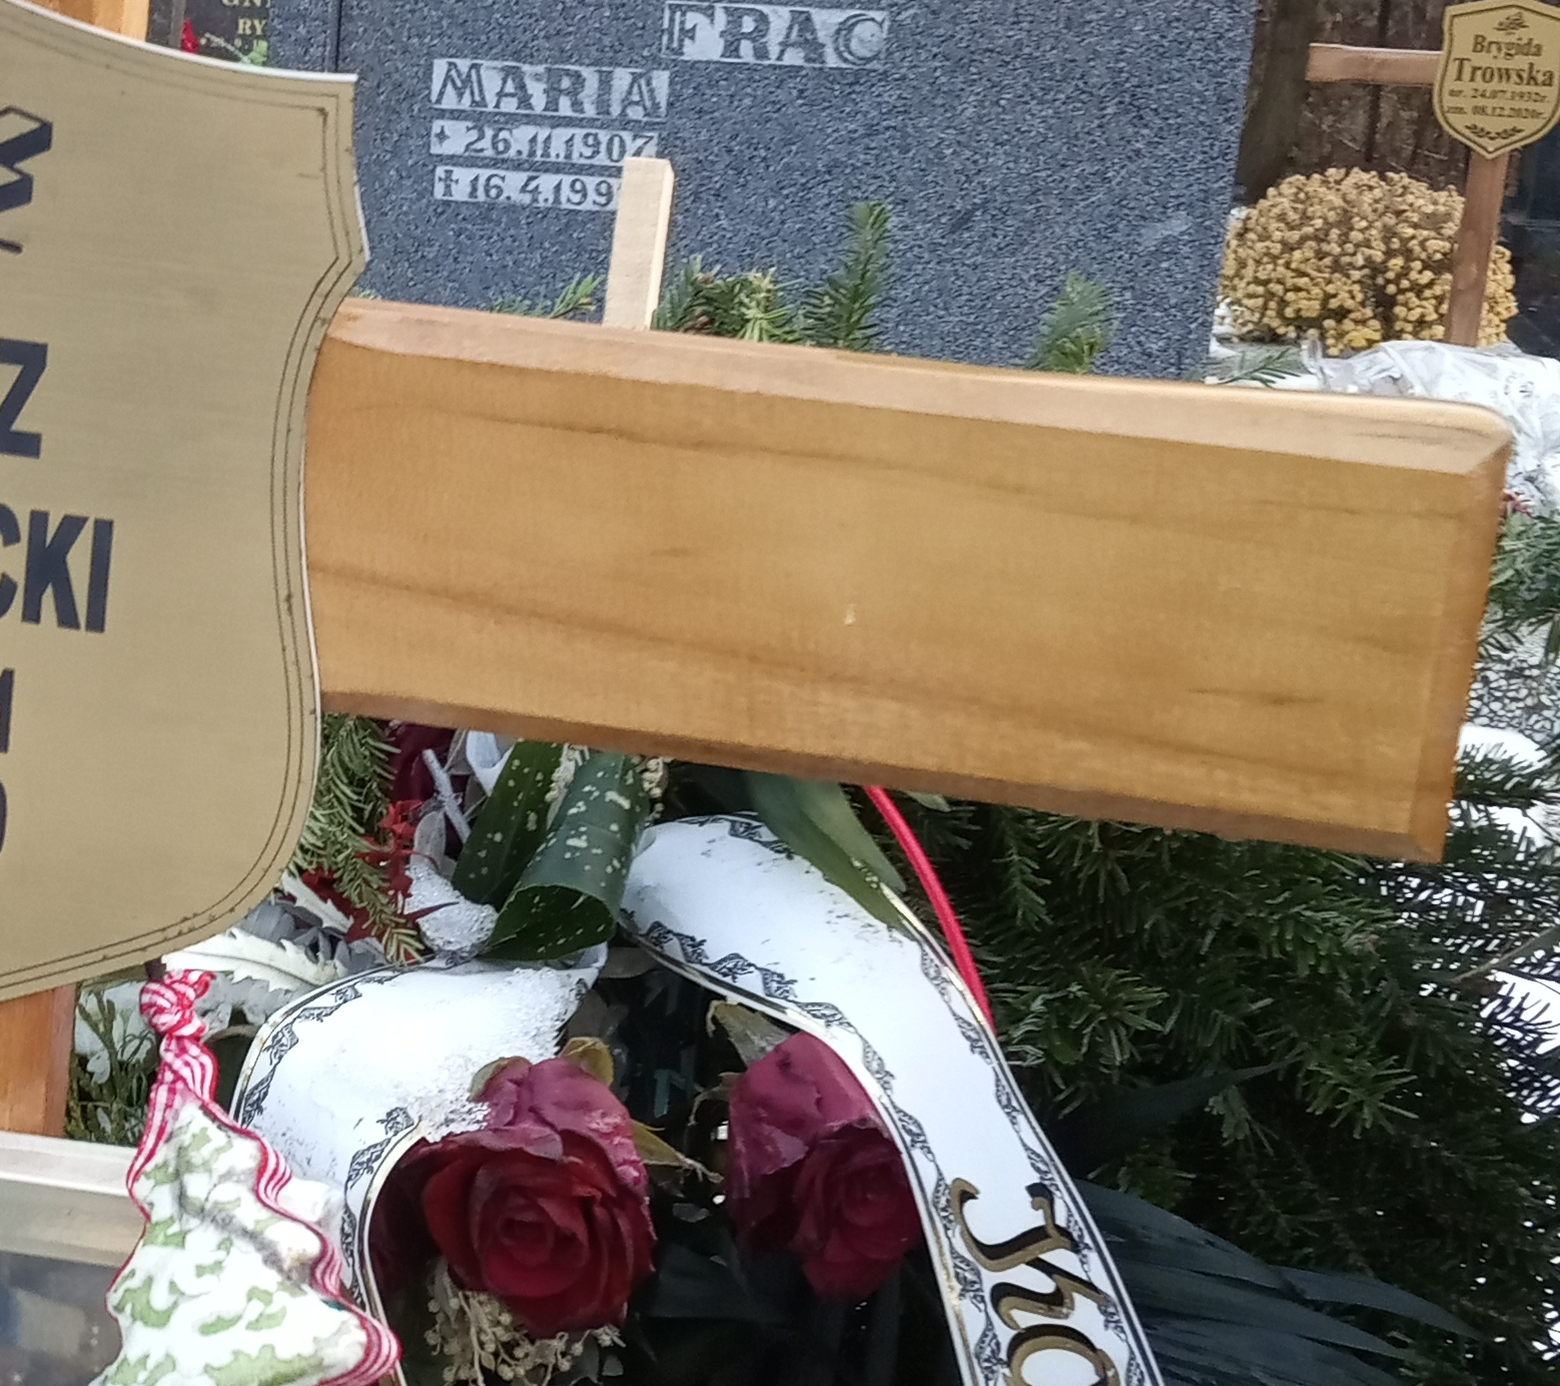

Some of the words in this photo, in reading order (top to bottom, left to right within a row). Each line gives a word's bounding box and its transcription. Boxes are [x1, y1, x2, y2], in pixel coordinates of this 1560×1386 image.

[1472, 34, 1543, 60] Brygida
[1453, 57, 1555, 87] Trowska
[436, 60, 661, 119] MARIA
[468, 172, 624, 210] 16.4.199
